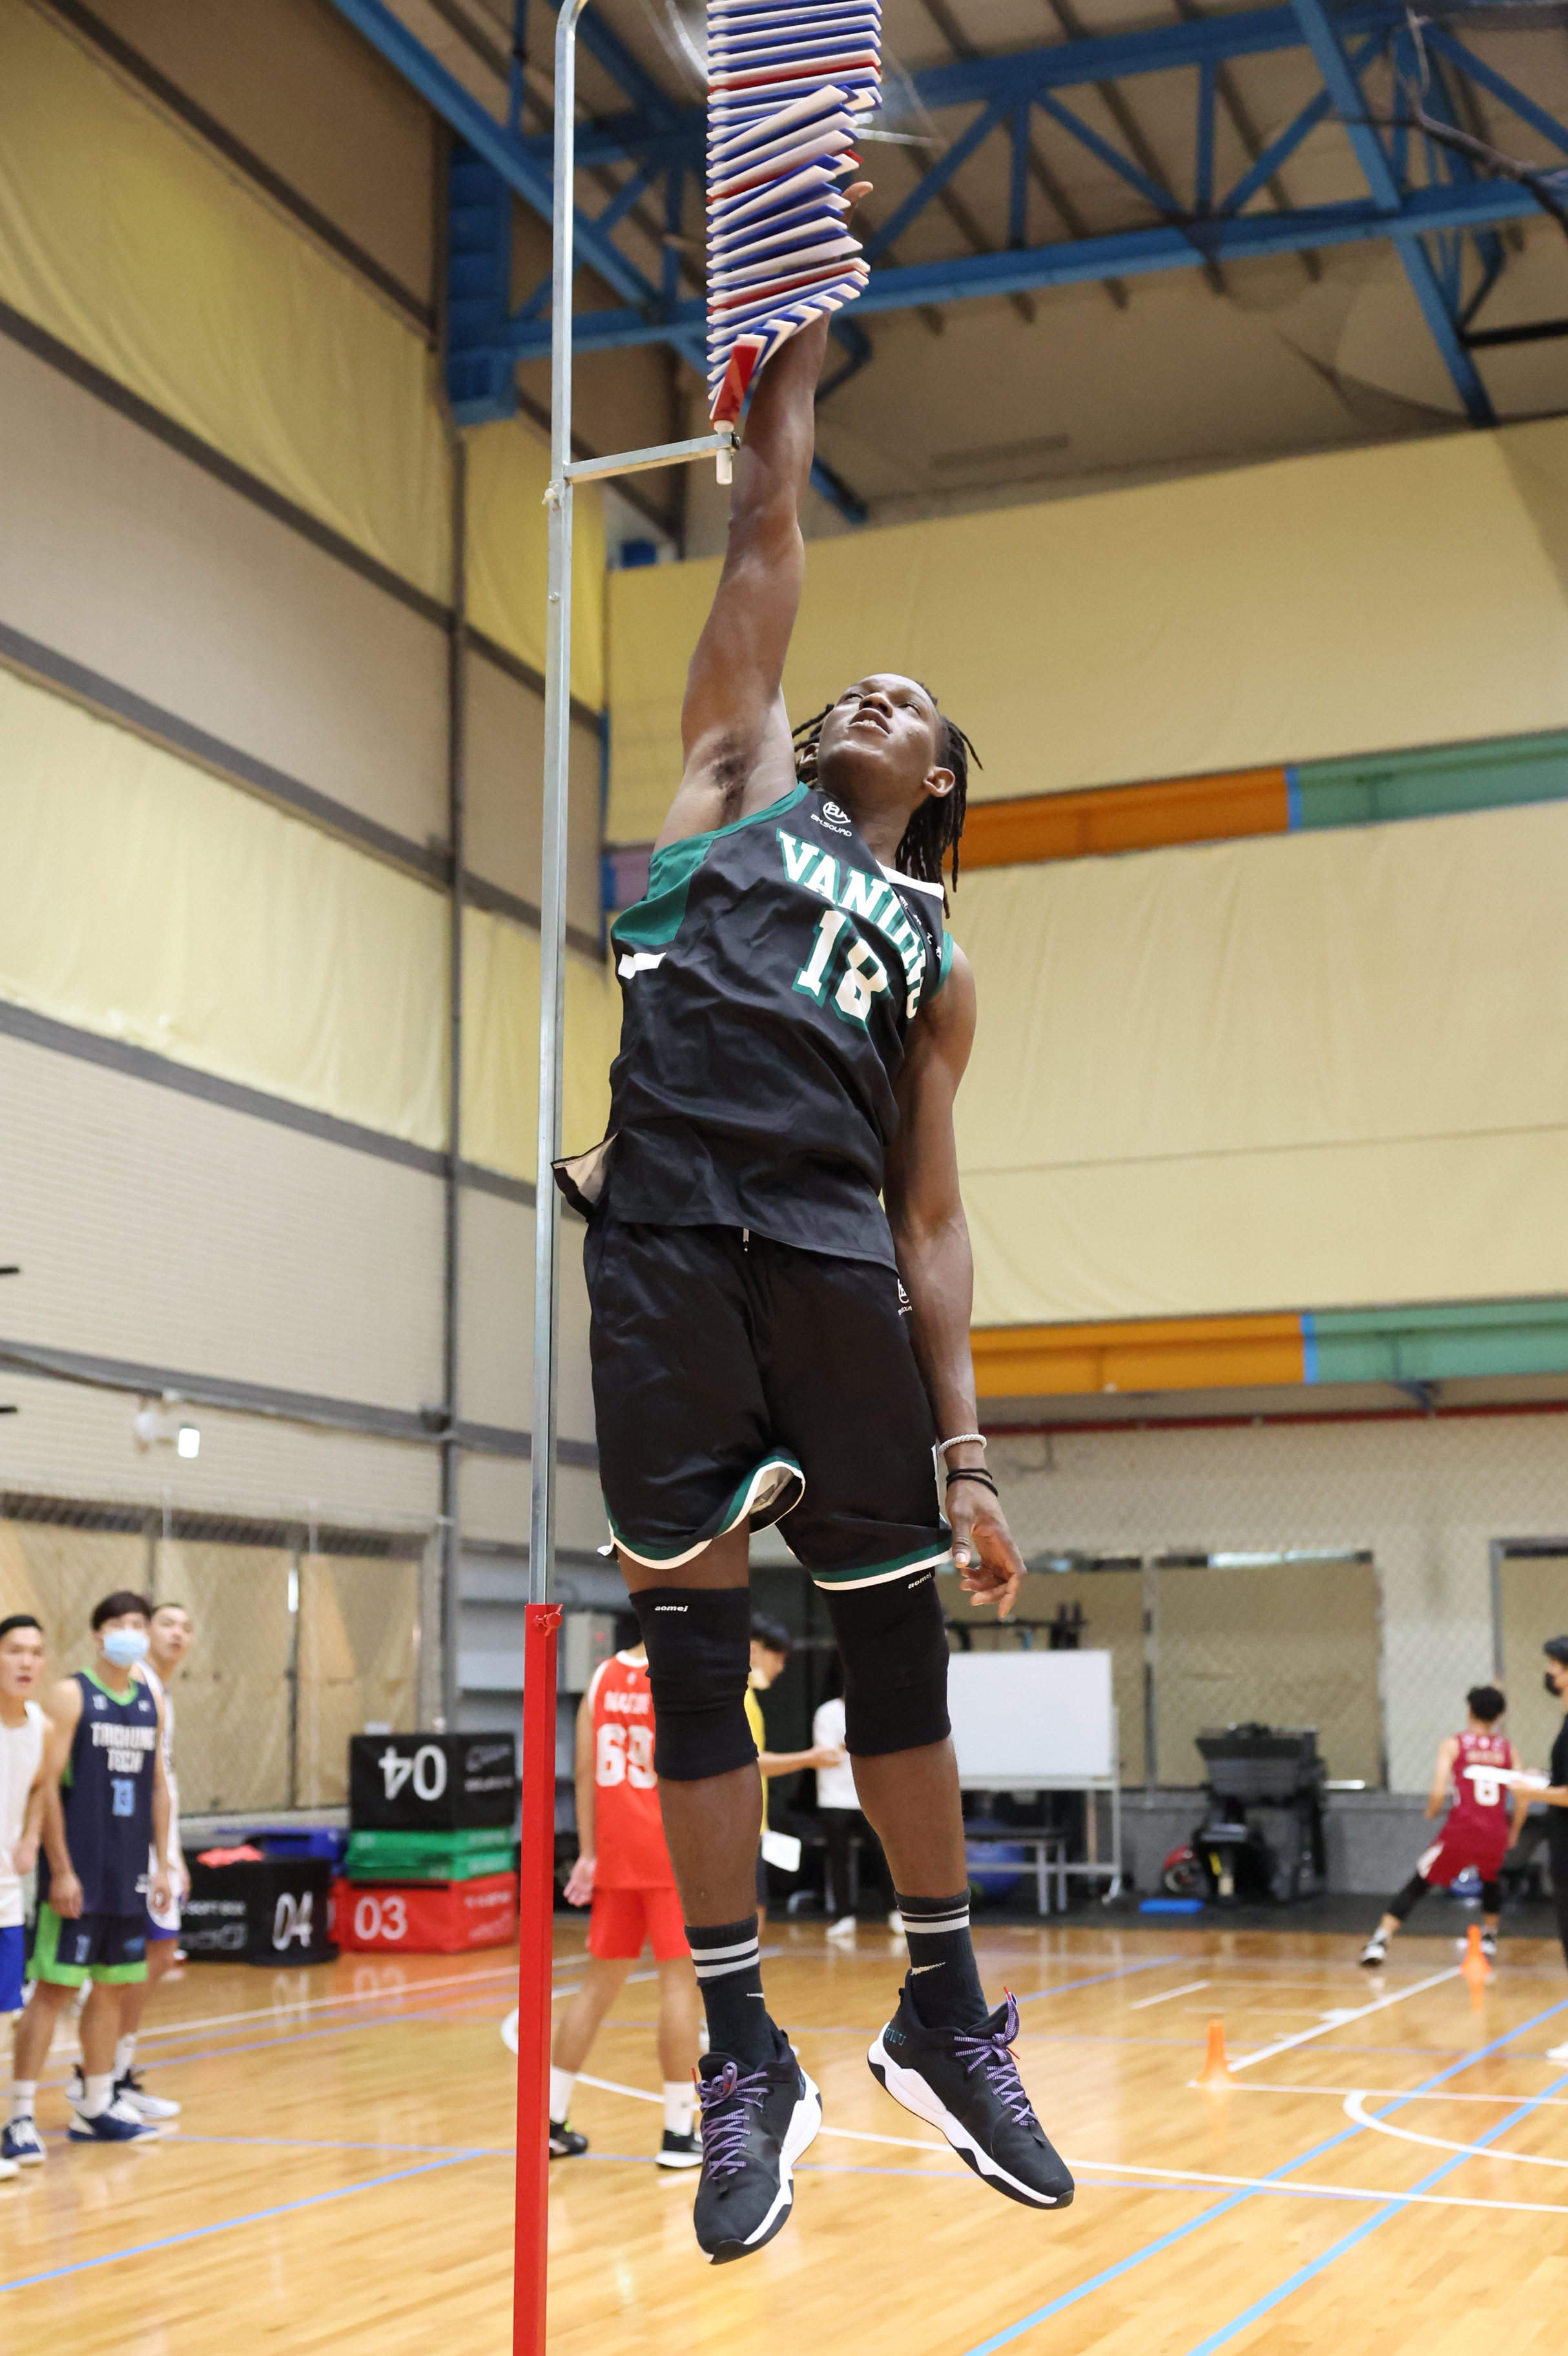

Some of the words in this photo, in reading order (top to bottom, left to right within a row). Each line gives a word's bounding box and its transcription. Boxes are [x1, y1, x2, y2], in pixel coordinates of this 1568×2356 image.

[794, 909, 889, 1026] 18
[378, 1744, 448, 1801] 04
[595, 1722, 658, 1790] 69
[272, 1890, 313, 1952] 04
[354, 1895, 407, 1940] 03
